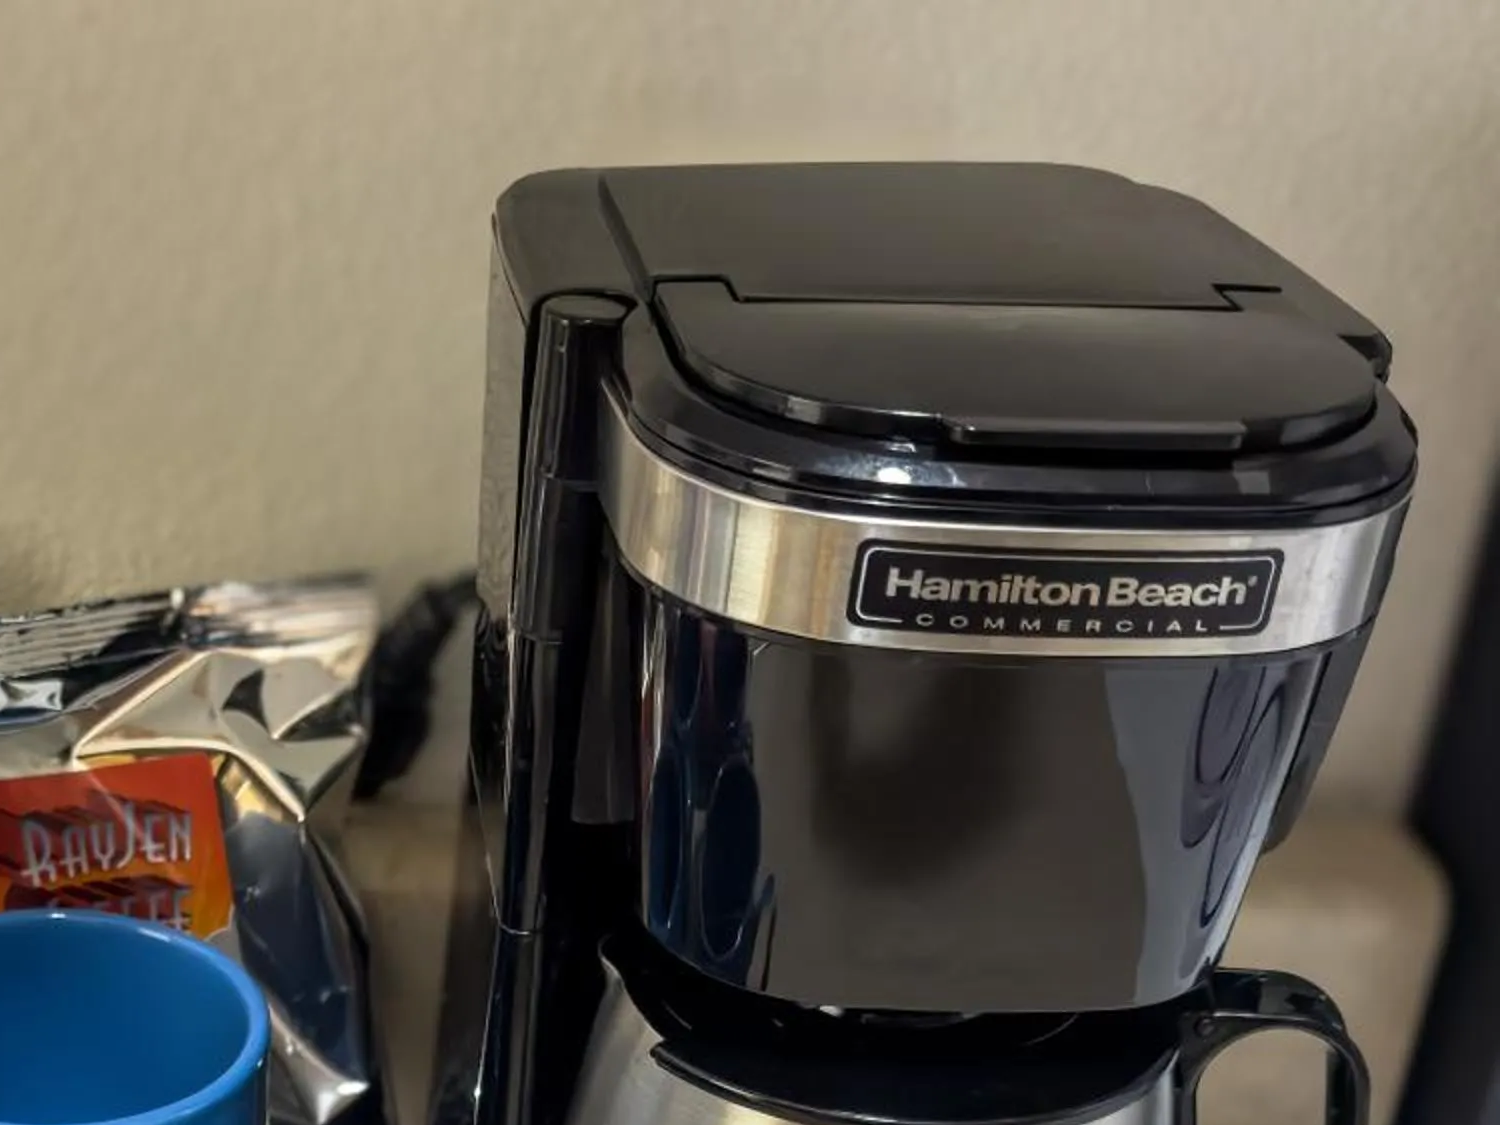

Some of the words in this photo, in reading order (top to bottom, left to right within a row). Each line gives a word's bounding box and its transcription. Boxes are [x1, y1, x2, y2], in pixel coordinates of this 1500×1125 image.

[885, 566, 1099, 606] Hamilton
[1106, 576, 1246, 607] Beach
[916, 612, 1208, 634] COMMERCIAL
